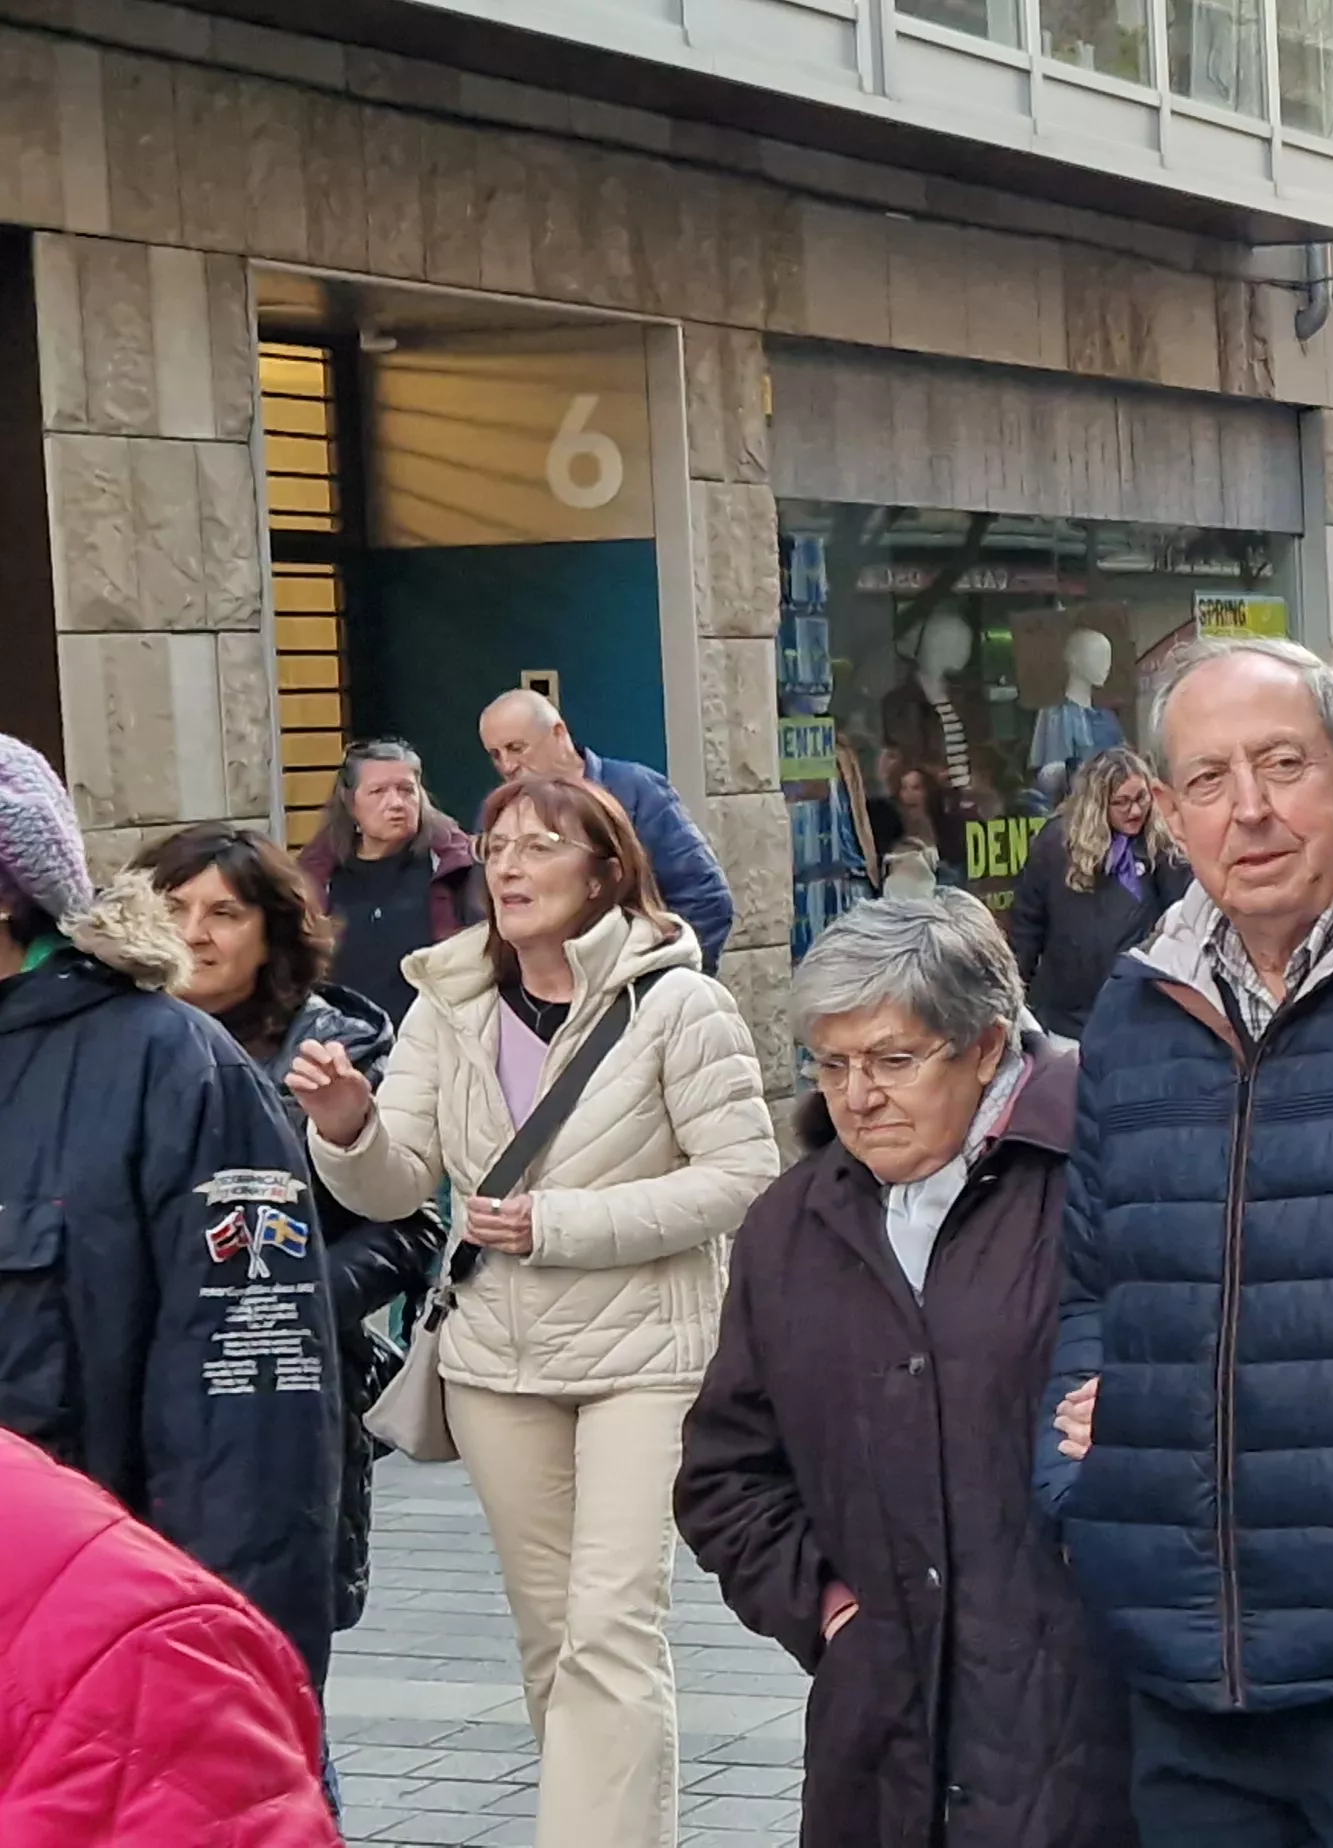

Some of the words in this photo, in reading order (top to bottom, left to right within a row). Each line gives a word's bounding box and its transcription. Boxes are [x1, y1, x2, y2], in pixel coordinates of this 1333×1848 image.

[546, 394, 623, 510] 6
[1199, 597, 1247, 628] SPRING
[779, 724, 834, 759] ENIM
